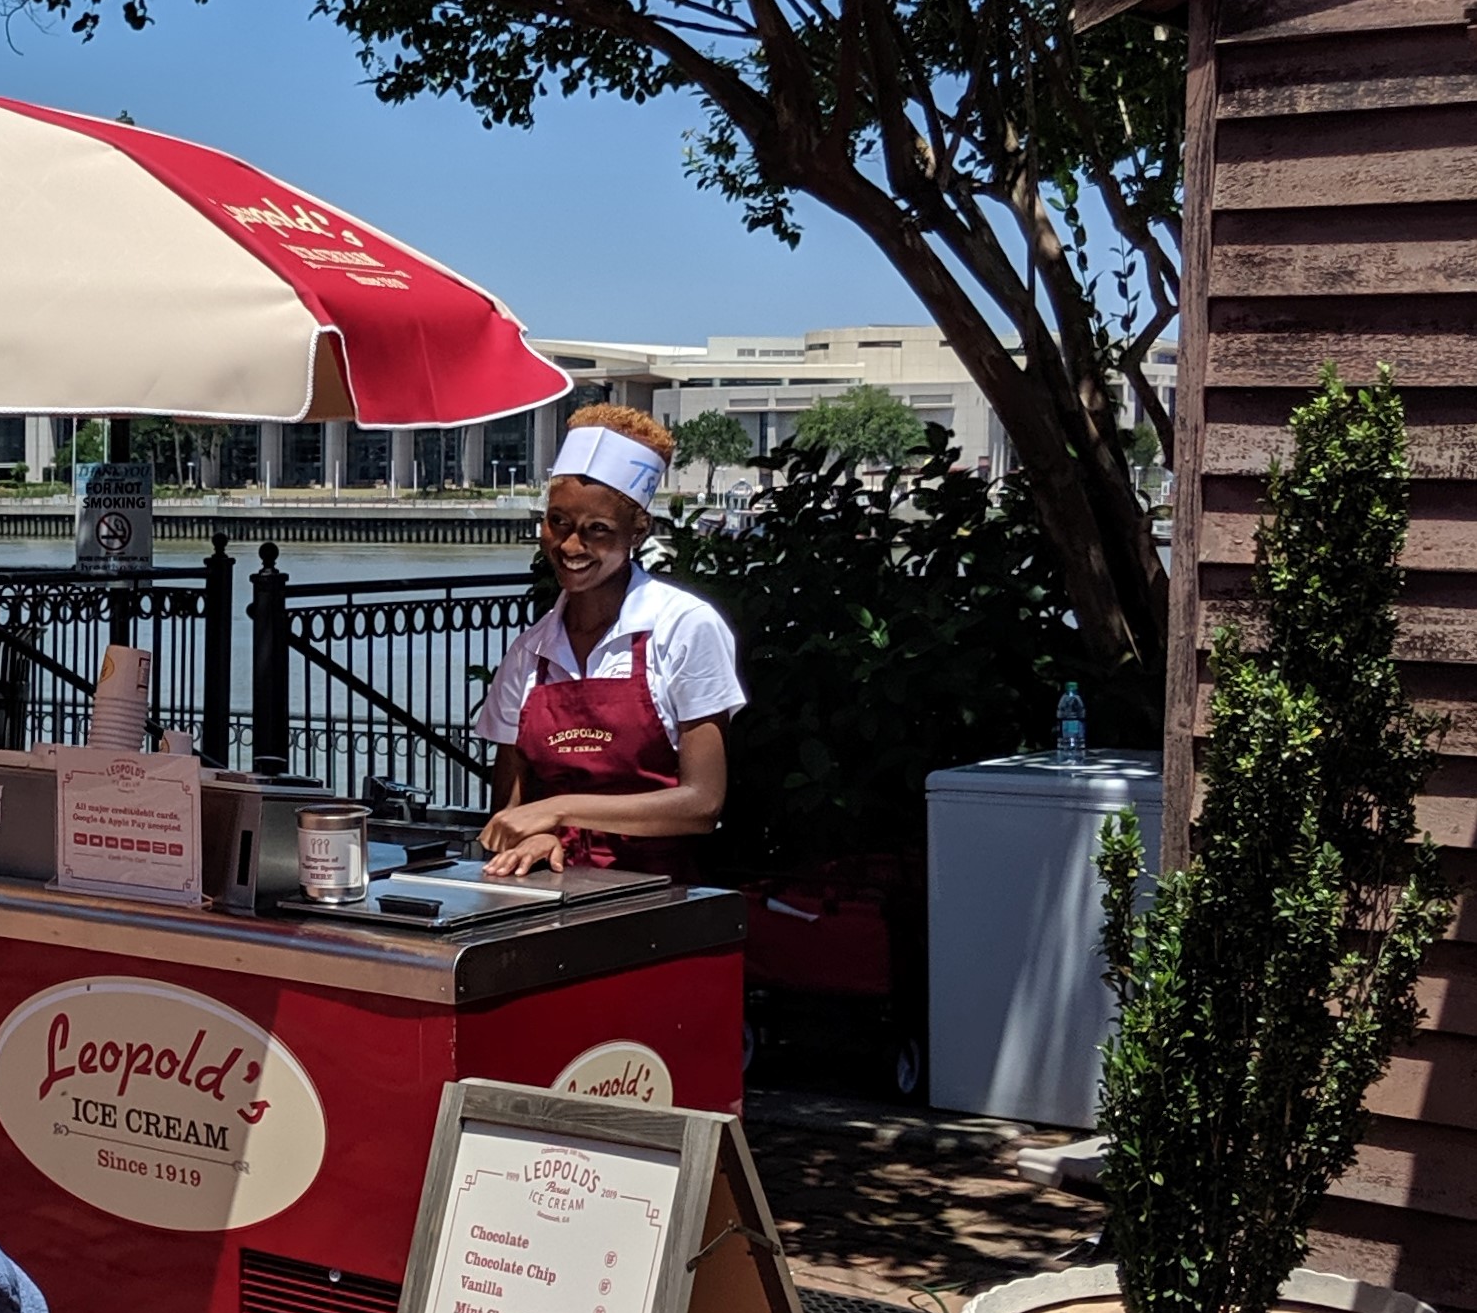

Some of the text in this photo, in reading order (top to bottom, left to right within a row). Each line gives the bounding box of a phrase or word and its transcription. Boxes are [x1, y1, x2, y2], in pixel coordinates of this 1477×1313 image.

[123, 466, 150, 477] YOU
[85, 482, 142, 495] FOR NOT
[83, 497, 146, 509] SMOKING
[547, 728, 613, 746] LEOPOLD'S
[558, 745, 603, 754] ICE CREAM
[106, 764, 147, 779] LEOPOLD'S
[75, 802, 86, 810] All
[88, 805, 110, 814] major
[73, 813, 98, 824] Google
[99, 816, 106, 824] &
[108, 818, 129, 828] Apple
[131, 820, 146, 829] Pay
[39, 1012, 272, 1125] Leopold's
[567, 1060, 654, 1103] opold's
[71, 1097, 230, 1152] ICE CREAM
[97, 1148, 202, 1187] Since 1919
[524, 1159, 601, 1193] LEOPOLD'S
[529, 1189, 585, 1211] ICE CREAM
[601, 1187, 618, 1199] 2019
[470, 1224, 529, 1250] Chocolate
[465, 1250, 557, 1286] Chocolate Chip
[460, 1274, 503, 1298] Vanilla
